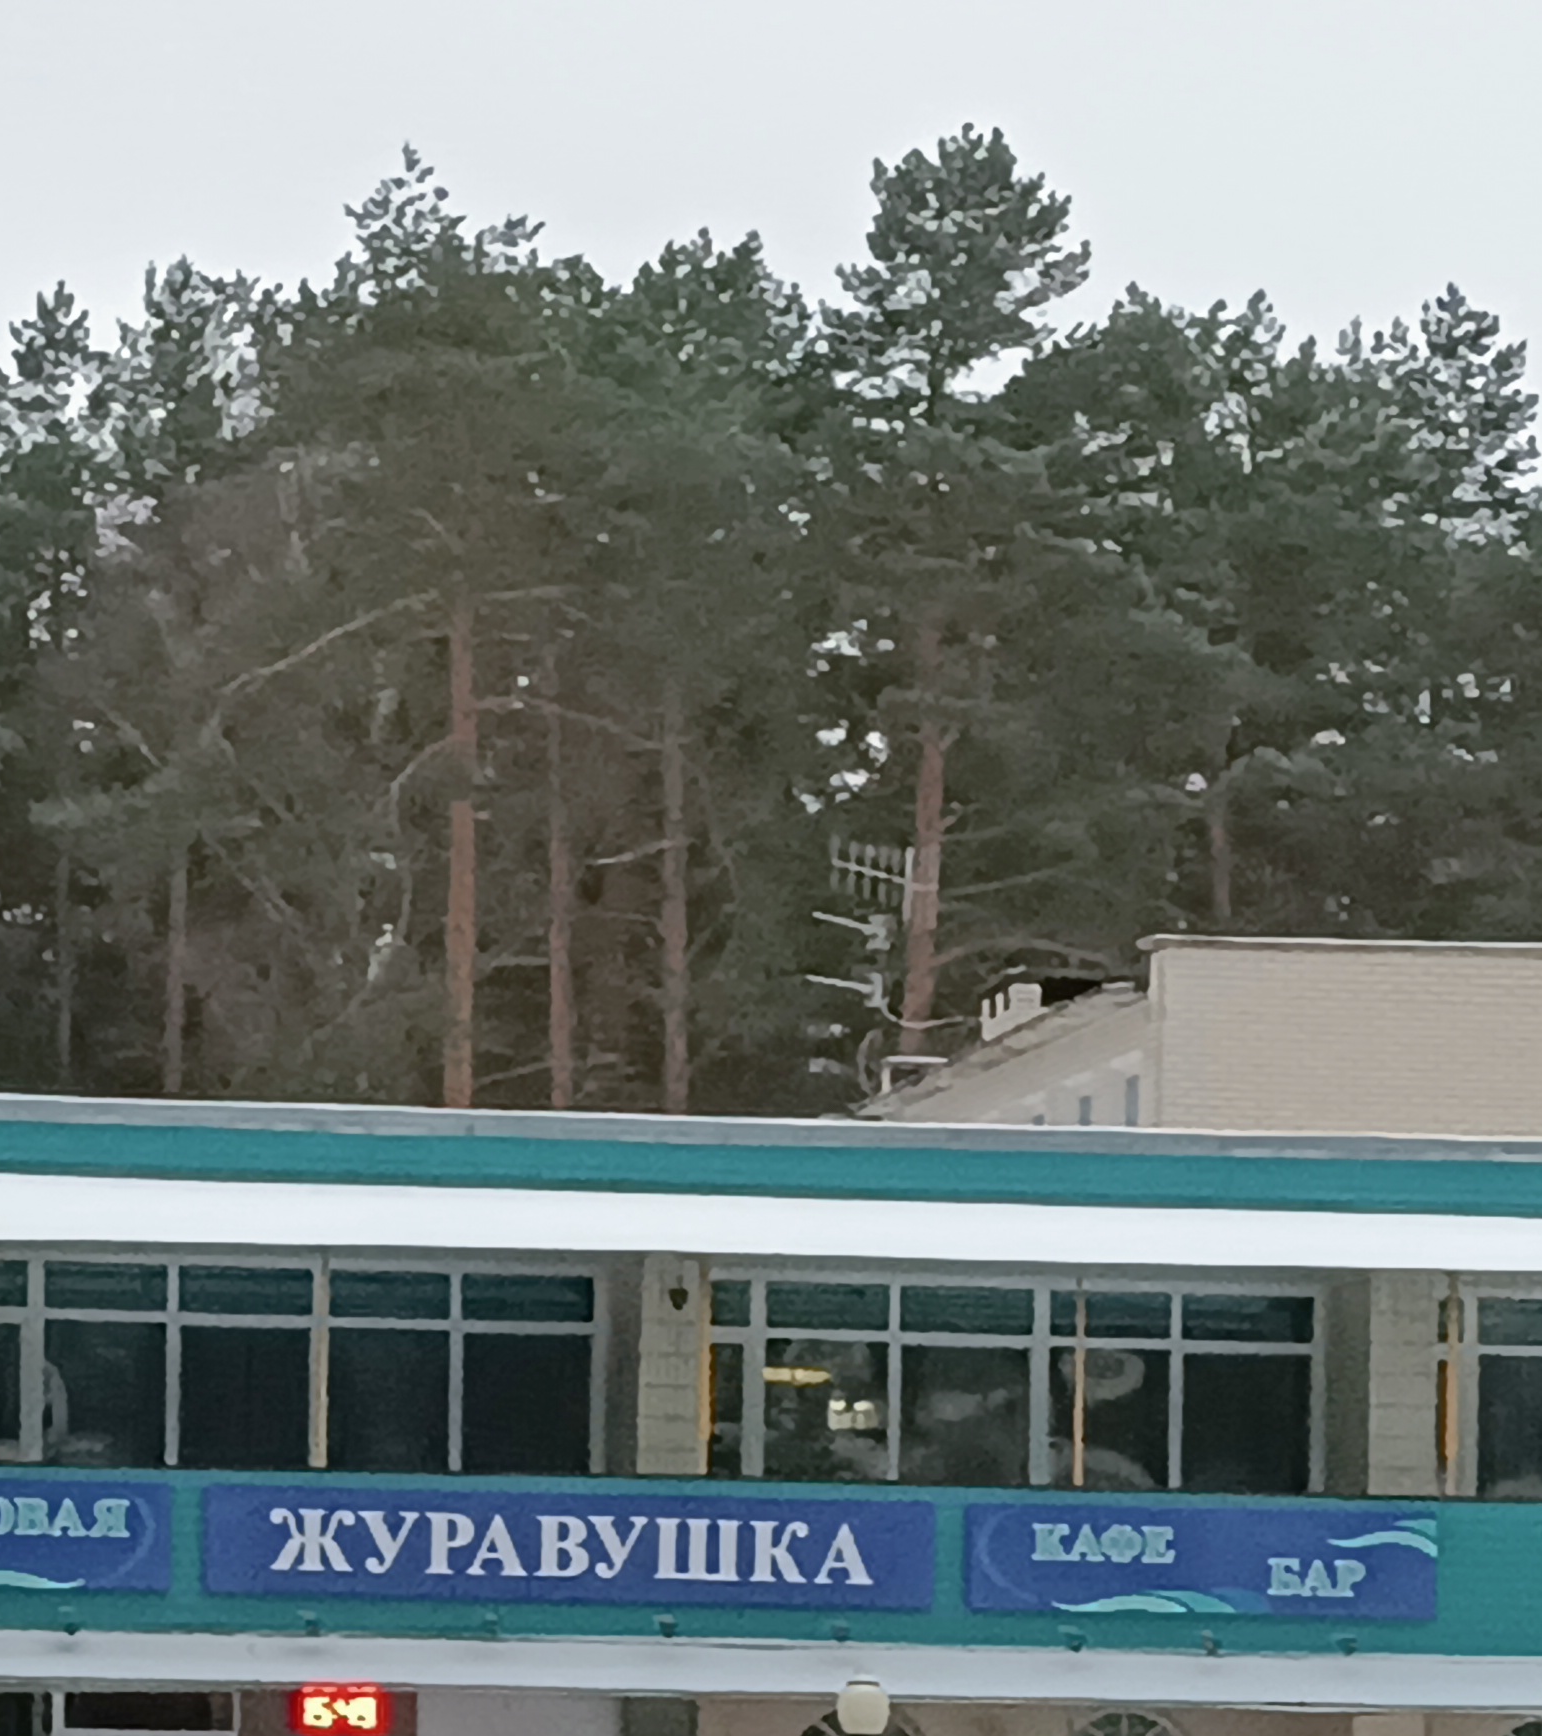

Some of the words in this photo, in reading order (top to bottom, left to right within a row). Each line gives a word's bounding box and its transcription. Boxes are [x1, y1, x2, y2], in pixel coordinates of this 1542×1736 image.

[269, 1506, 874, 1586] ЖУРАВУШКА
[1031, 1522, 1176, 1564] КАФЕ
[1266, 1556, 1368, 1598] БАР
